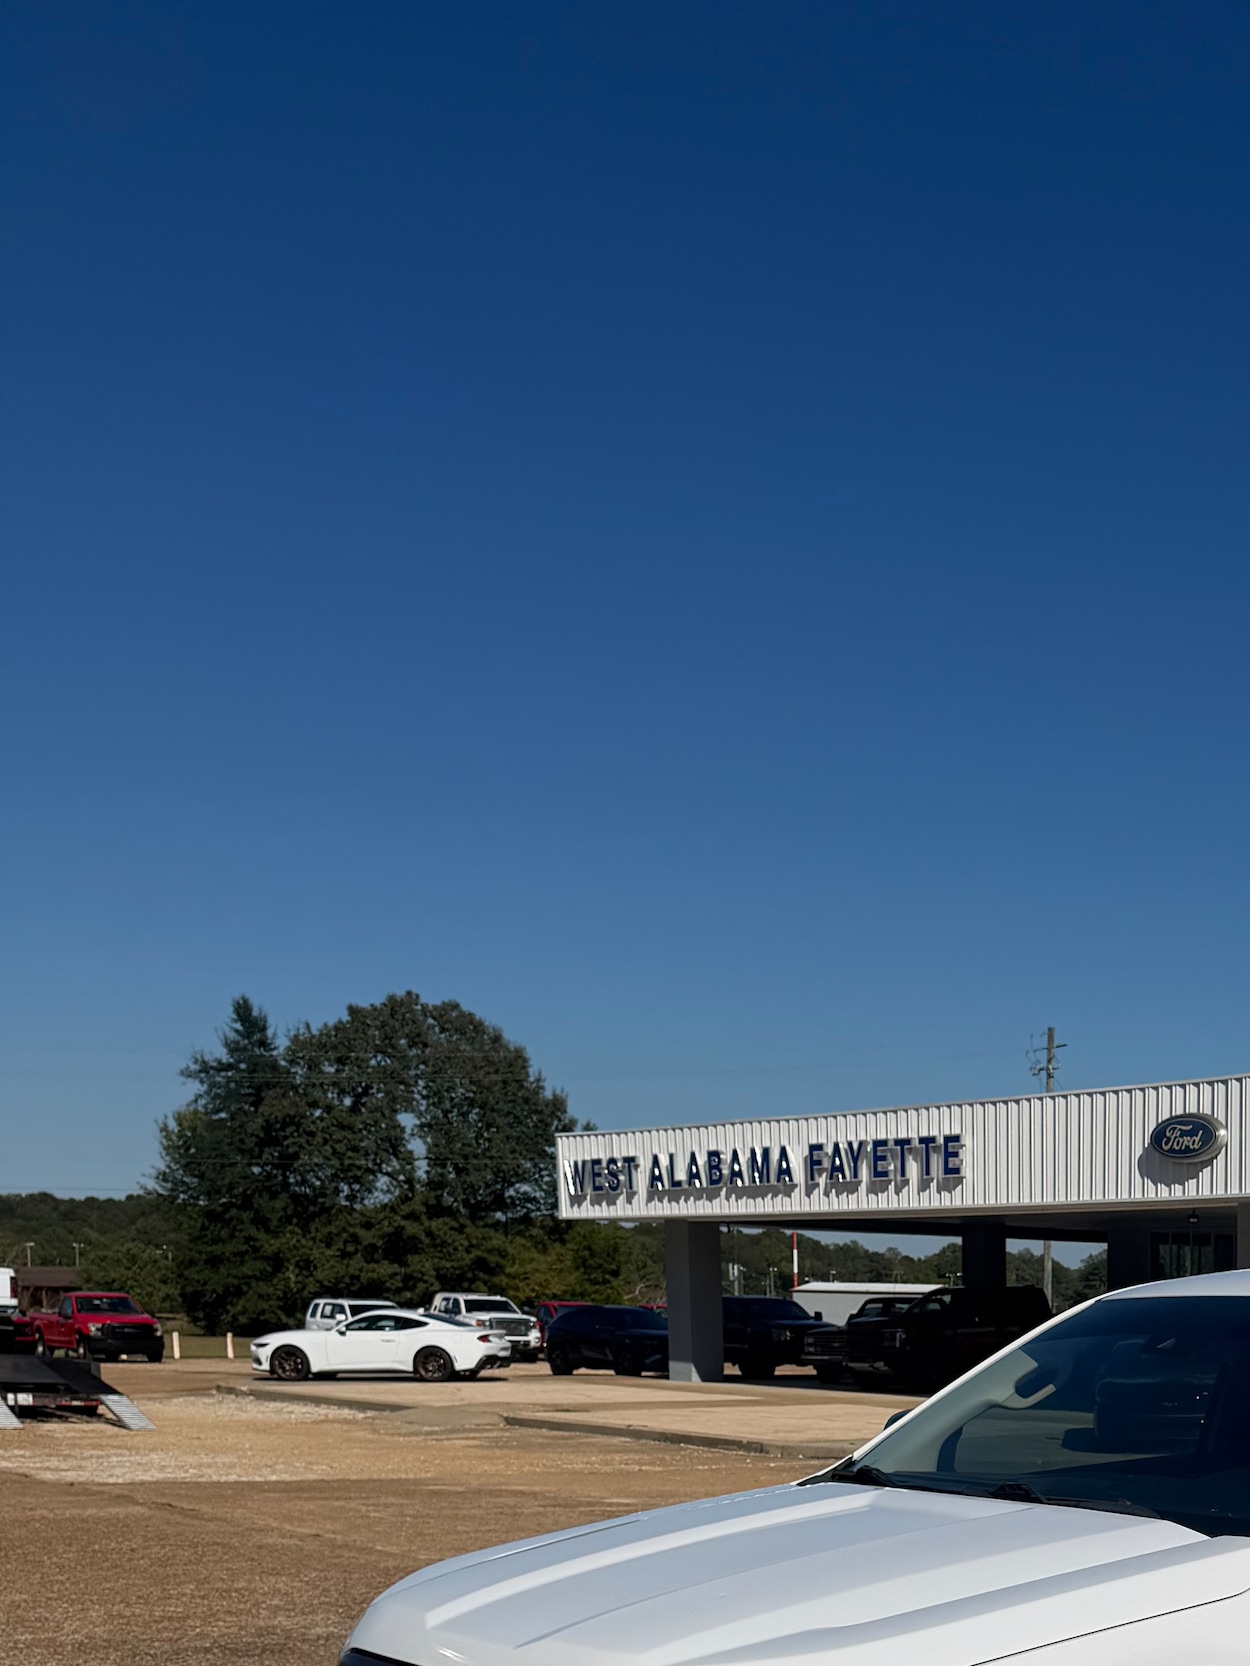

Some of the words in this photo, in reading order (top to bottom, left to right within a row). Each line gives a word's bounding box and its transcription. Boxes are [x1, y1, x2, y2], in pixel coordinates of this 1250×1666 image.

[1161, 1124, 1204, 1152] Ford
[564, 1156, 637, 1196] WEST
[651, 1145, 794, 1191] ALABAMA
[808, 1134, 961, 1182] FAYETTE
